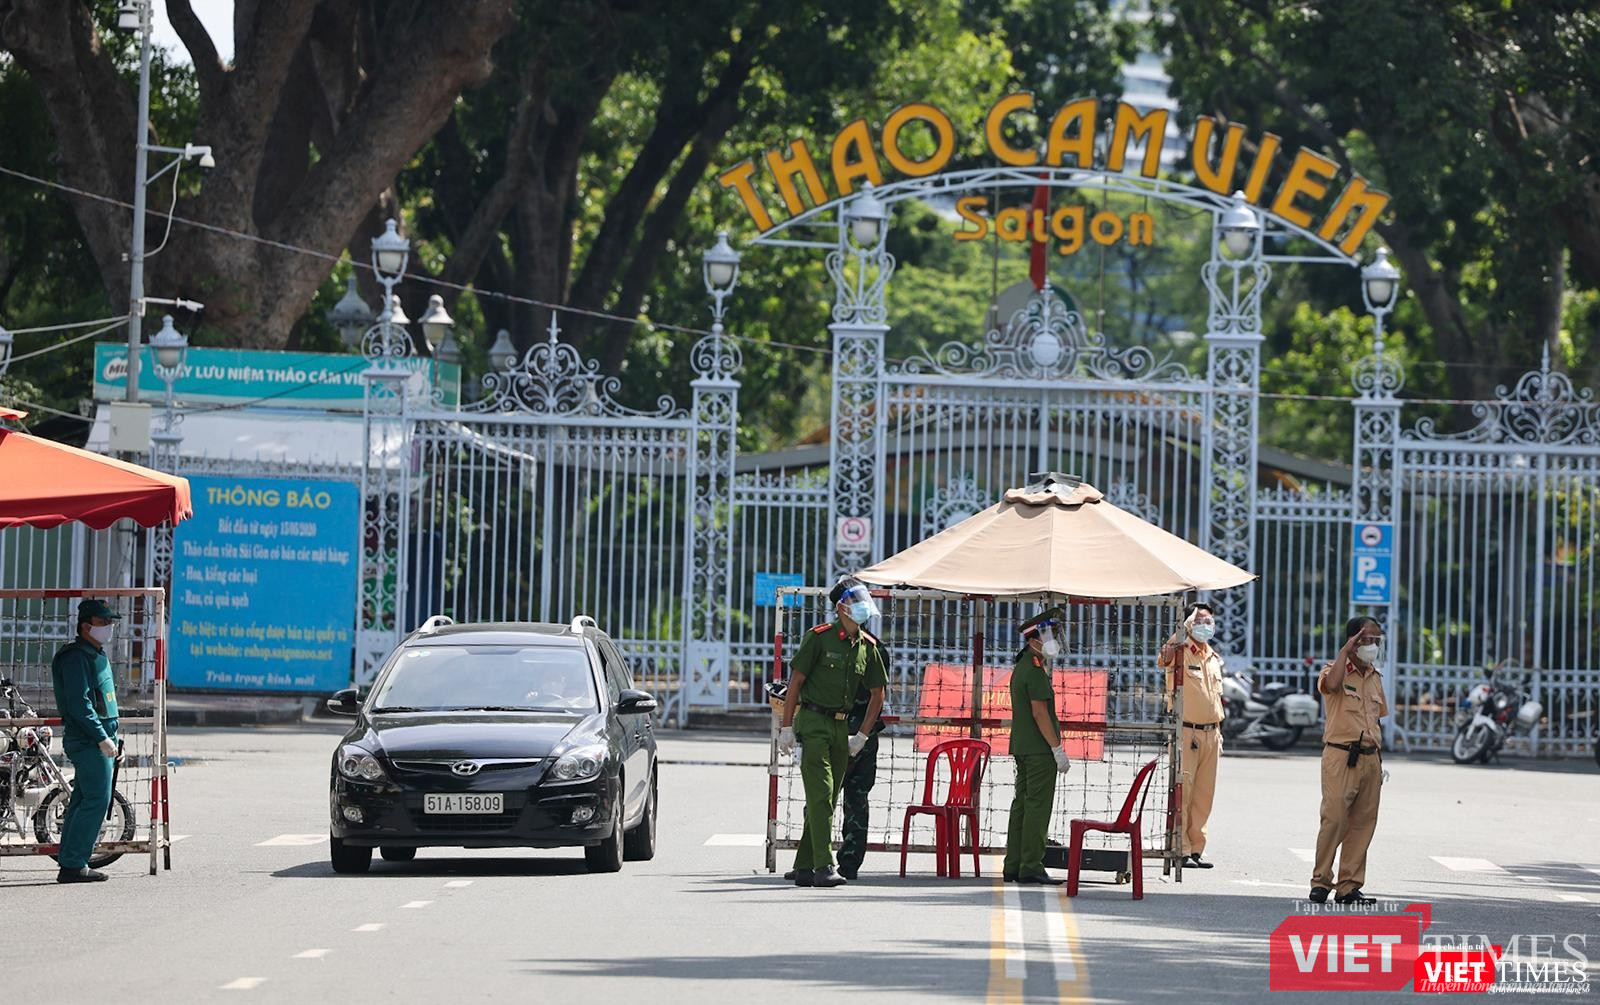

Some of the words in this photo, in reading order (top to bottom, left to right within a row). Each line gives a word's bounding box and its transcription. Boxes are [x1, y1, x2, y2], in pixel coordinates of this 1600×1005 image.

[719, 102, 955, 233] THAO
[985, 92, 1169, 178] CAM
[953, 196, 1154, 255] Saigon
[228, 365, 264, 384] NIỆM
[266, 366, 306, 383] THẢO
[207, 485, 280, 507] THÔNG
[286, 486, 331, 509] BÁO
[428, 796, 500, 811] 51A-158.09
